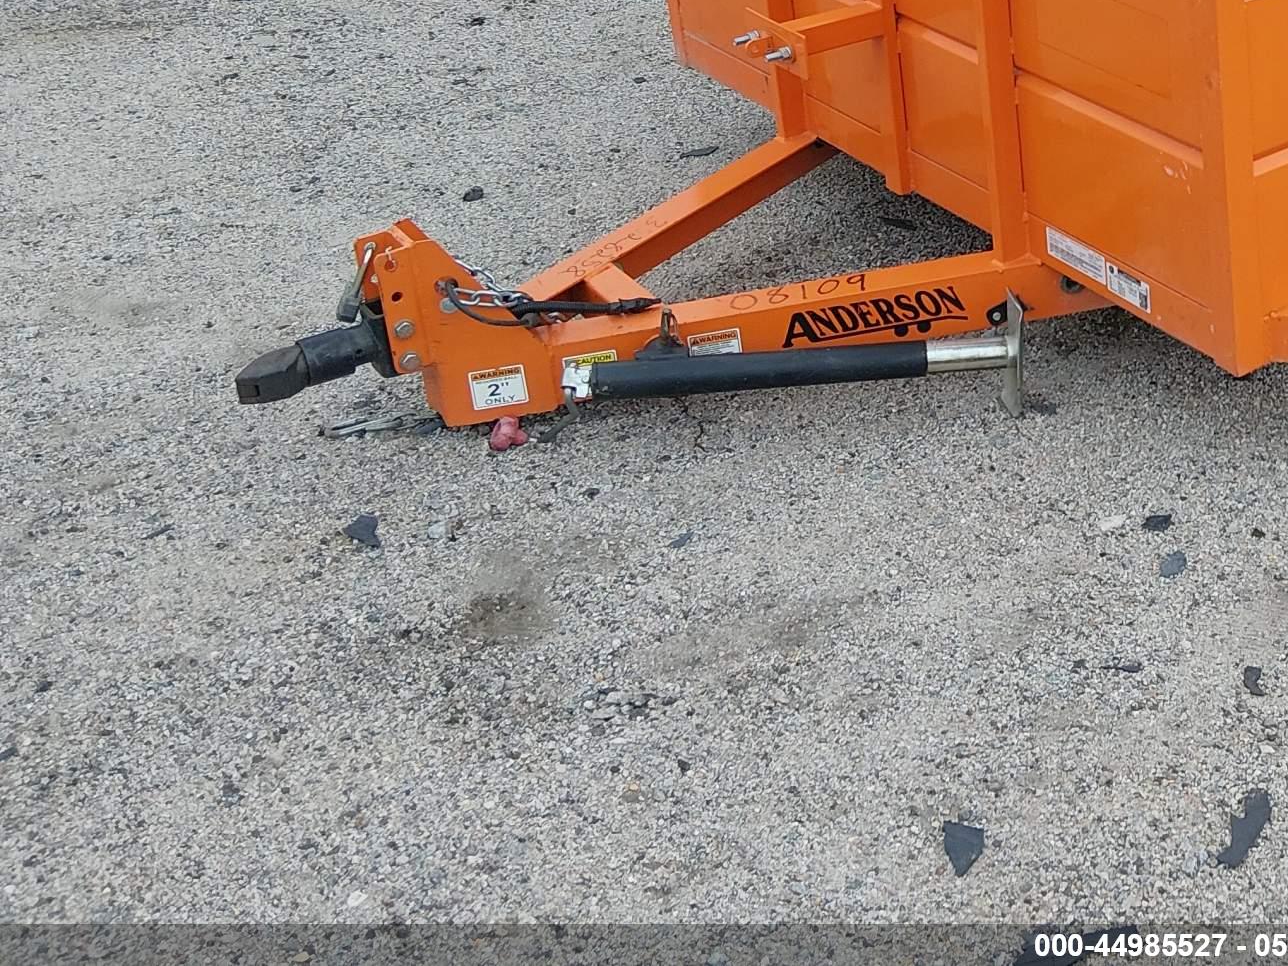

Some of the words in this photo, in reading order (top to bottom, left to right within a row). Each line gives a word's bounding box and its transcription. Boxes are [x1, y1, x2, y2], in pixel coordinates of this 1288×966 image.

[730, 274, 866, 311] 08109
[782, 285, 967, 348] ANDERSON
[699, 331, 737, 344] WARNING
[576, 354, 612, 365] CAUTION
[479, 367, 520, 379] WARNING
[487, 381, 510, 397] 2"
[485, 394, 515, 405] ONLY
